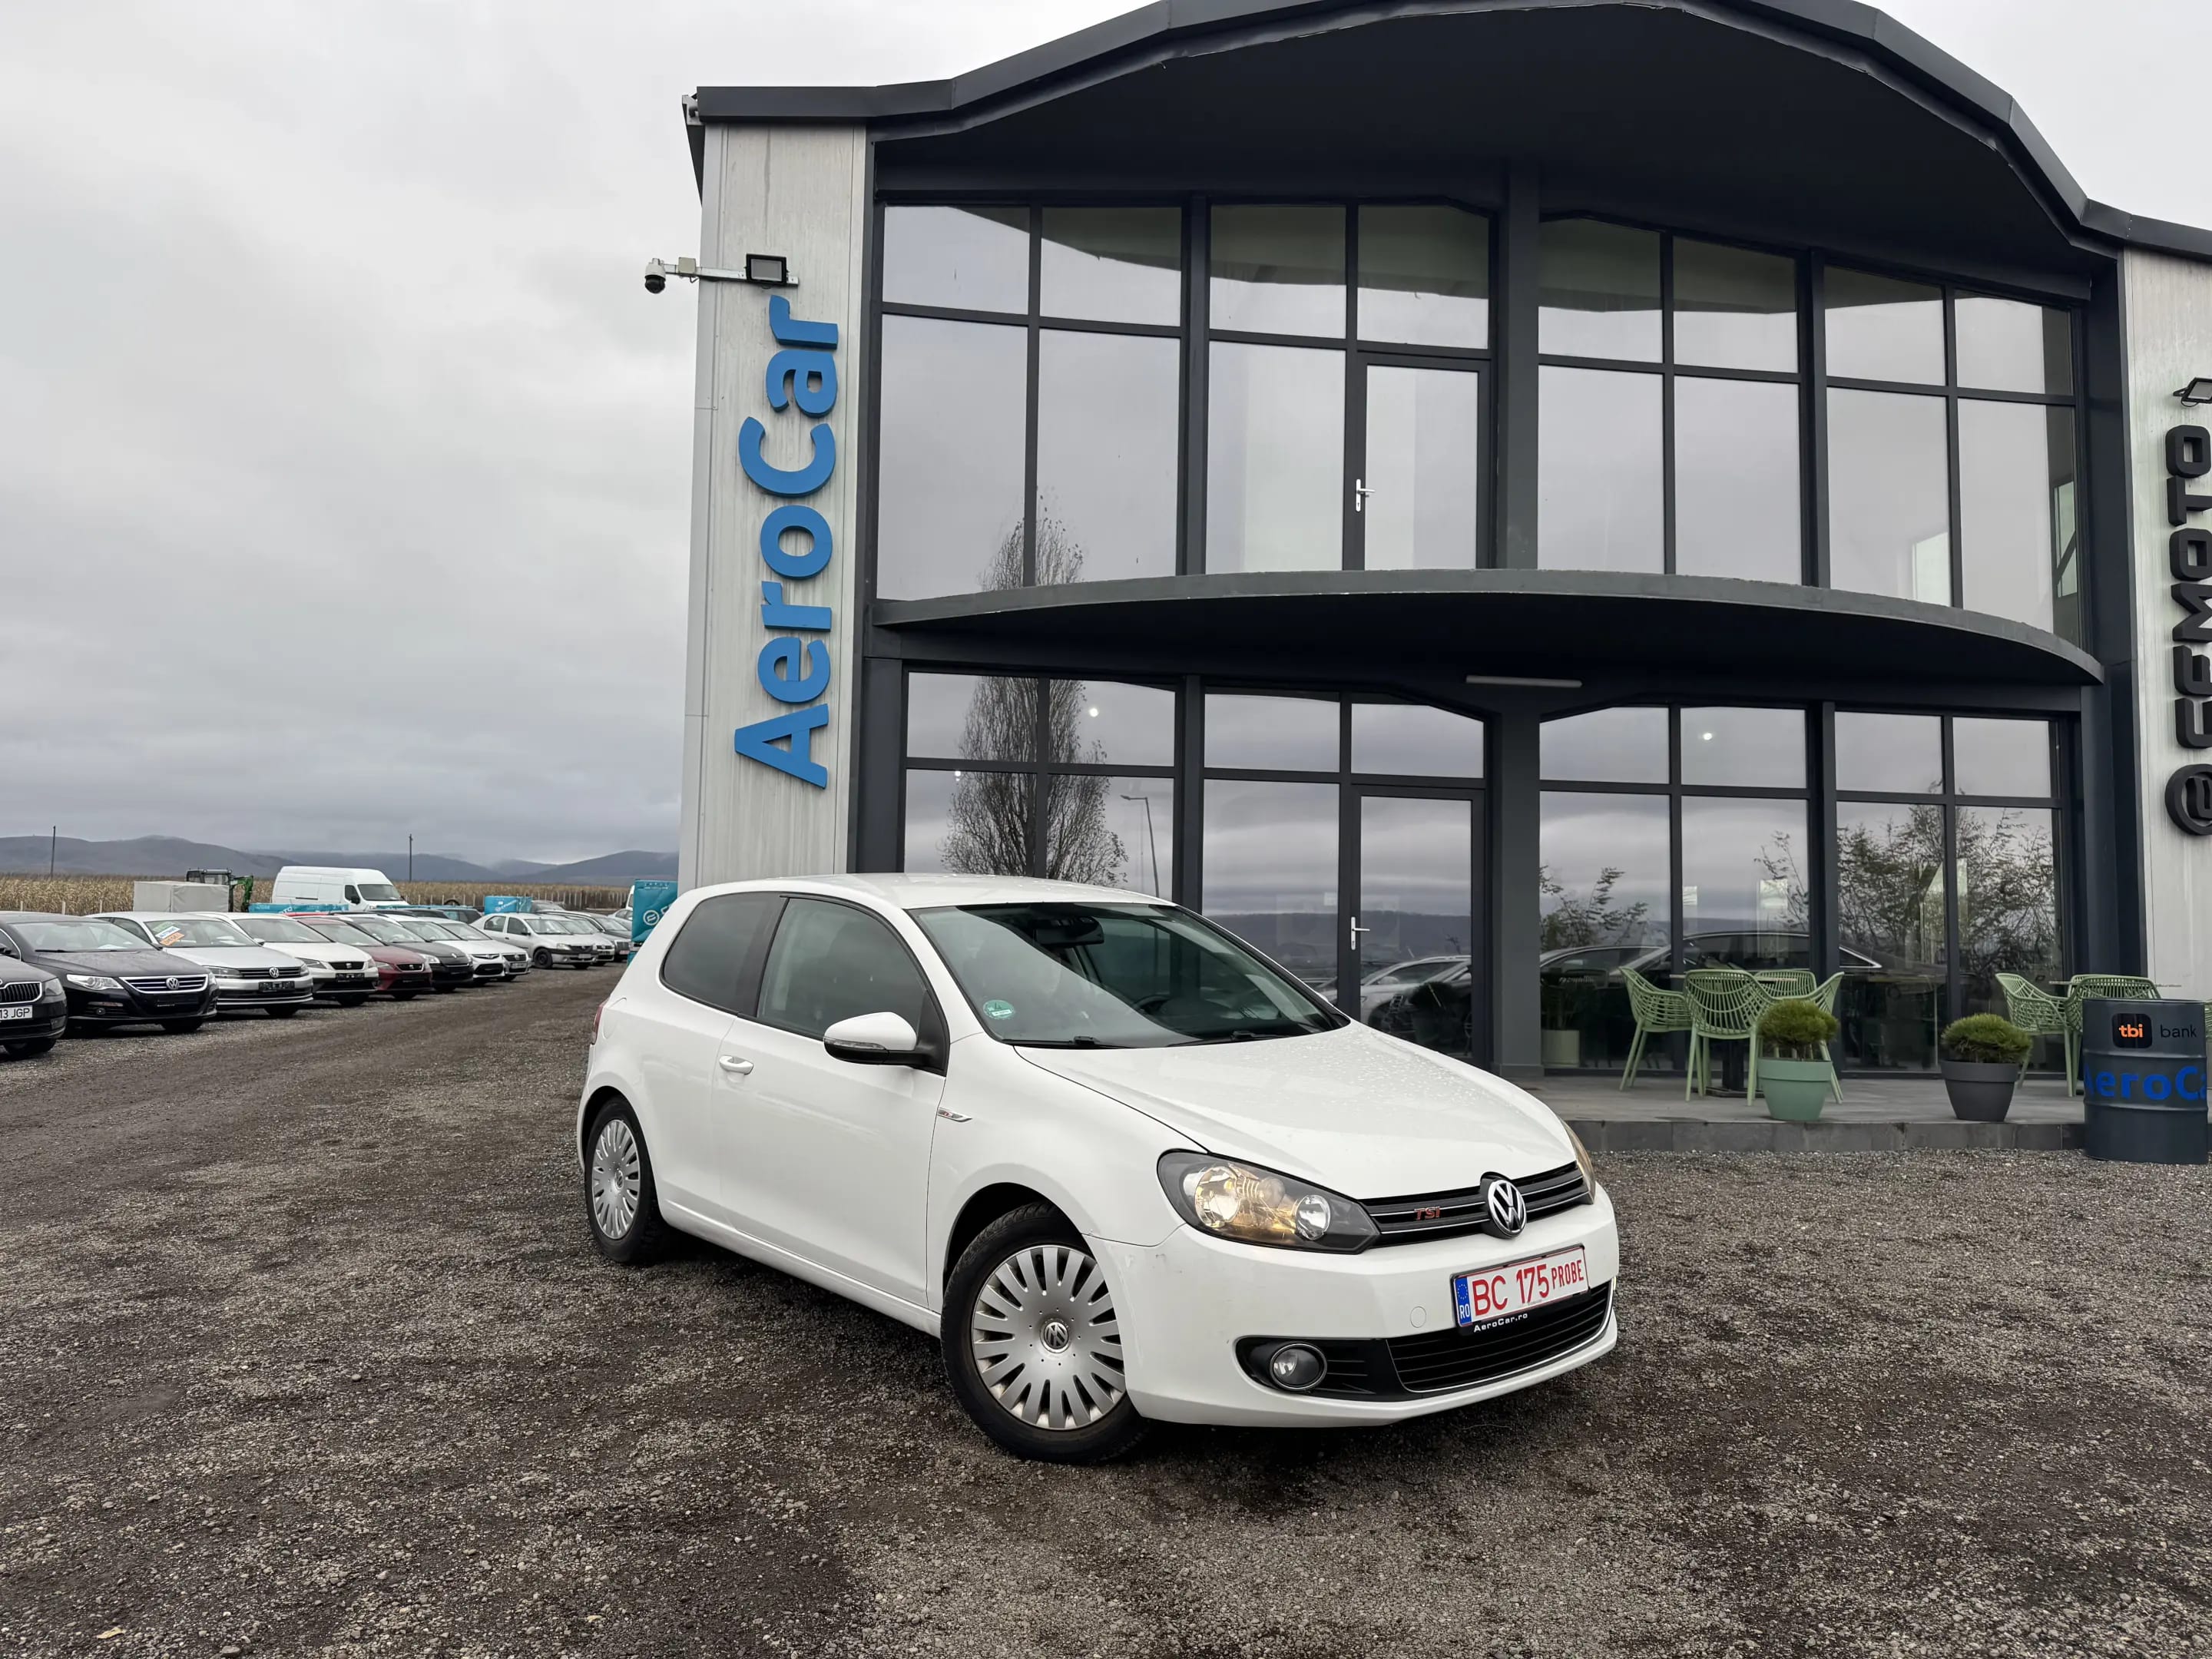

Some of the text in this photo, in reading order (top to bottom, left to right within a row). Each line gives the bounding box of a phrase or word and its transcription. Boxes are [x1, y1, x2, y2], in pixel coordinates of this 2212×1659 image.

[733, 294, 839, 790] AeroCar
[11, 1008, 30, 1018] JGP
[2118, 1024, 2197, 1038] tbi bank
[1413, 1206, 1441, 1221] TSI
[1459, 1259, 1584, 1320] RO BC 175 PROBE
[1473, 1313, 1528, 1333] AeroCar.ro
